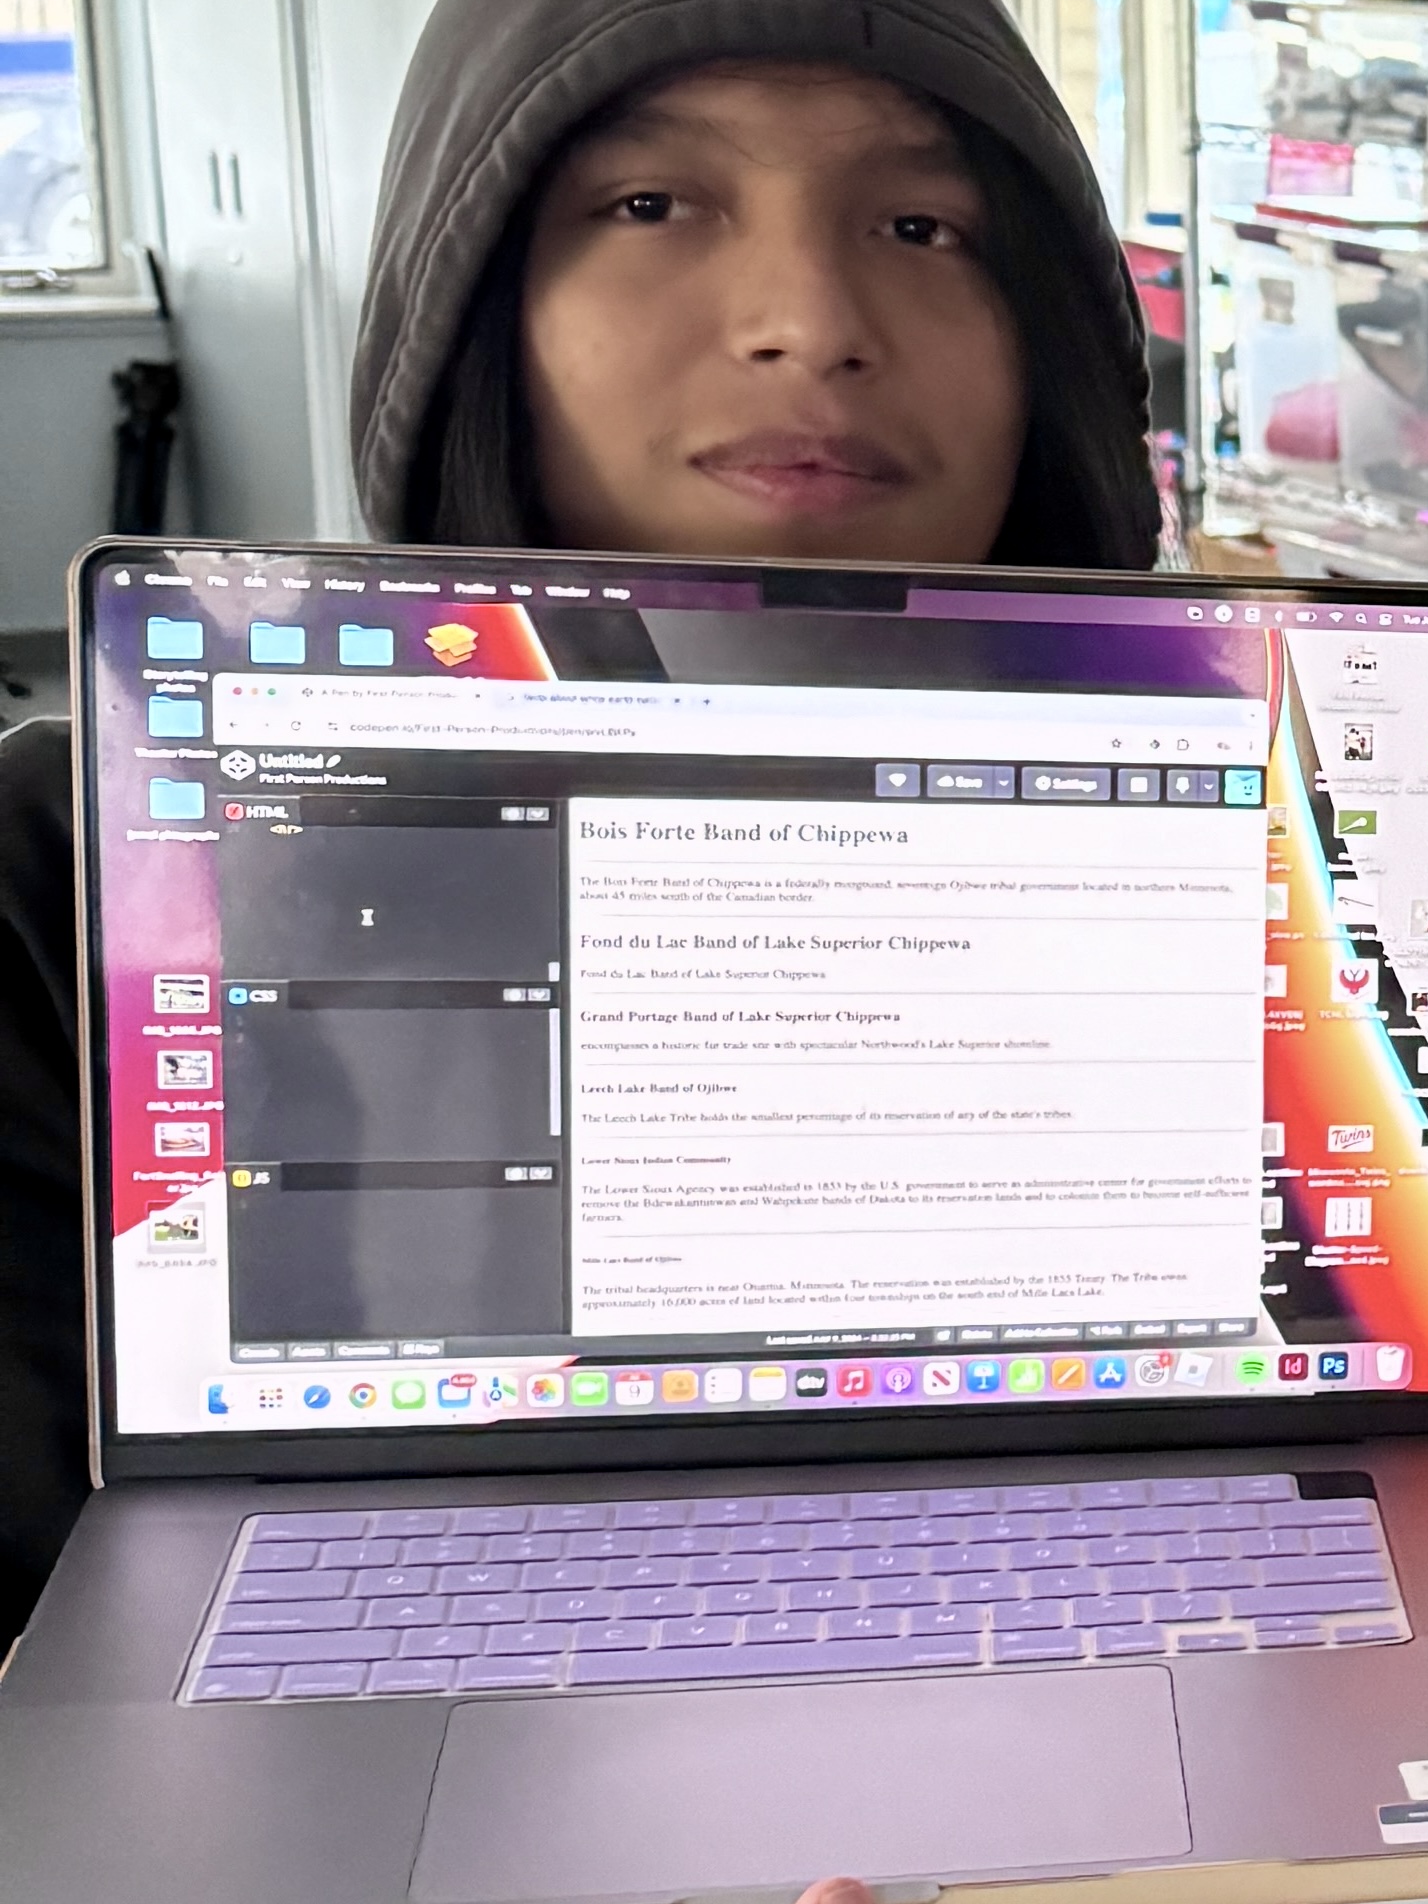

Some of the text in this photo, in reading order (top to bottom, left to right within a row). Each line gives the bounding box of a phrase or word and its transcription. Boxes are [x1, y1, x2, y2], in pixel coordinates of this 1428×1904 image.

[259, 753, 324, 769] Untitled
[259, 773, 285, 784] First
[323, 774, 387, 786] Productions
[246, 805, 289, 819] HTML
[580, 821, 908, 848] Bois Forte Band of Chippewa
[580, 876, 600, 886] The
[692, 877, 705, 887] of
[691, 892, 704, 902] of
[706, 892, 723, 902] the
[725, 892, 776, 902] Canadian
[580, 934, 971, 954] Fond du Lac Band of Lake Superior Chippewa
[580, 969, 607, 978] Fond
[626, 968, 646, 979] Lac
[650, 968, 678, 979] Band
[680, 968, 693, 979] of
[695, 968, 721, 979] Lake
[724, 969, 770, 980] Superior
[772, 969, 826, 982] Chippewa
[250, 989, 278, 1002] CSS
[580, 1010, 901, 1025] Grand Portage Band of Lake Superior Chippewa
[928, 1039, 955, 1049] Lake
[581, 1083, 737, 1096] Leech Lake Band of Ojibwe
[581, 1113, 602, 1123] The
[604, 1113, 637, 1123] Leech
[639, 1113, 667, 1123] Lake
[731, 1112, 748, 1122] the
[750, 1111, 794, 1122] smallest
[855, 1111, 866, 1121] of
[943, 1110, 955, 1120] of
[977, 1109, 990, 1120] of
[991, 1110, 1008, 1120] the
[1331, 1128, 1371, 1147] Twins
[581, 1157, 611, 1165] Lower
[253, 1171, 271, 1185] JS
[582, 1185, 601, 1195] The
[582, 1285, 602, 1296] The
[605, 1285, 634, 1295] tribal
[1284, 1358, 1302, 1375] Id
[1322, 1358, 1345, 1375] Ps
[628, 1383, 641, 1399] 9
